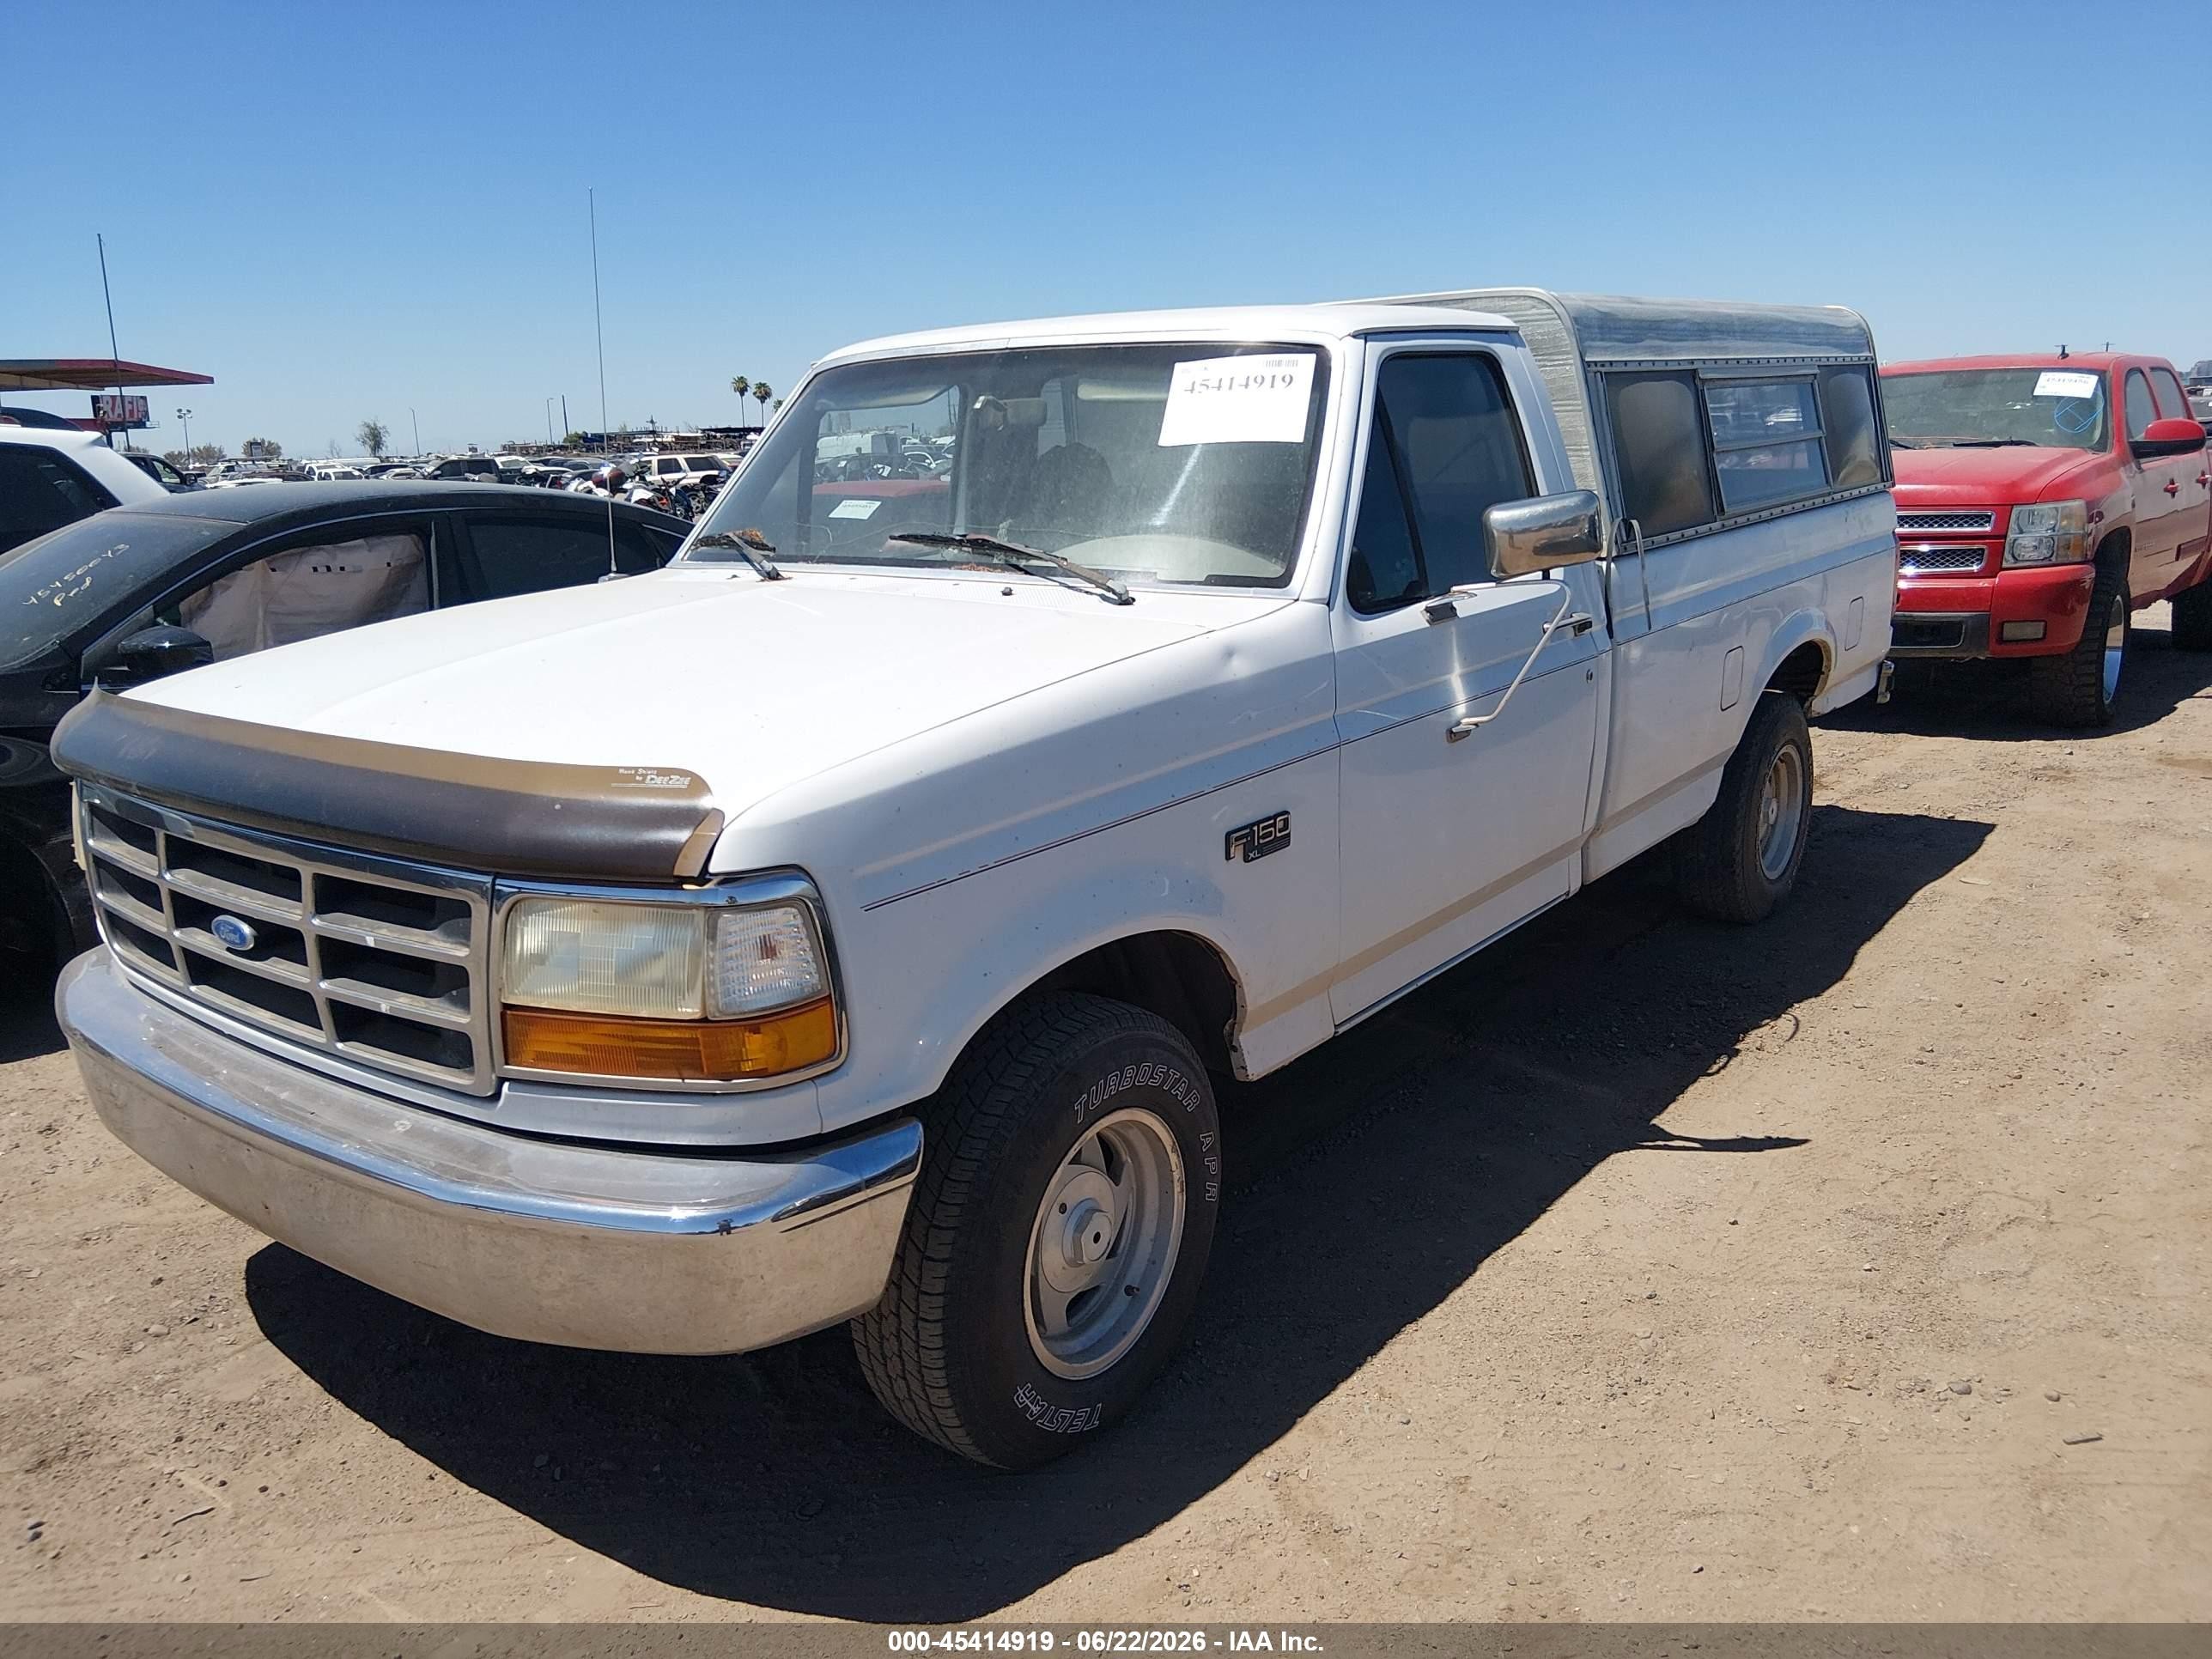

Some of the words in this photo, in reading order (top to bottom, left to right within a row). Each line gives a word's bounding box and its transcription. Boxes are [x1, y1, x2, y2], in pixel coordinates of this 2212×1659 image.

[1184, 374, 1294, 394] 45414919
[1248, 849, 1262, 860] XL
[1074, 1062, 1201, 1125] TURBOSTAR
